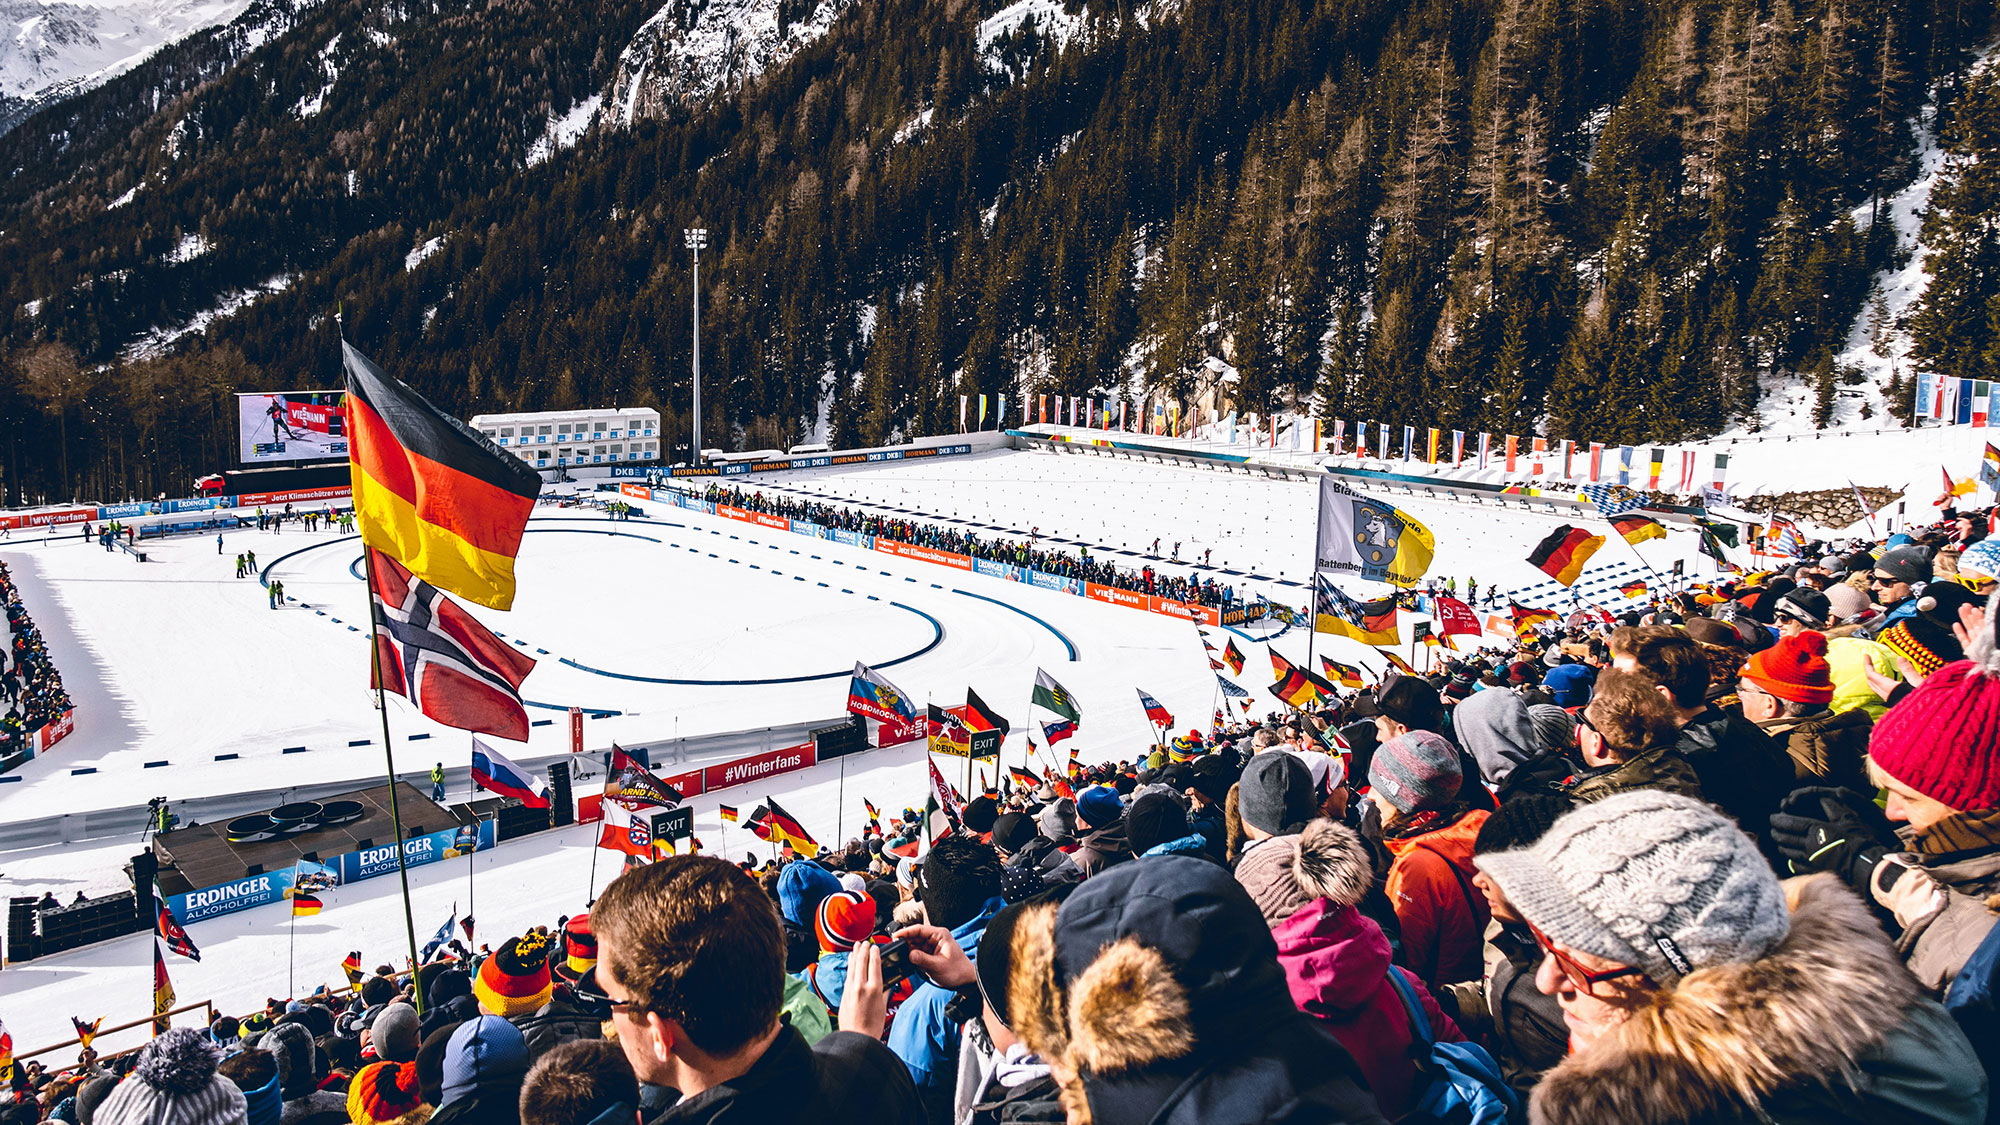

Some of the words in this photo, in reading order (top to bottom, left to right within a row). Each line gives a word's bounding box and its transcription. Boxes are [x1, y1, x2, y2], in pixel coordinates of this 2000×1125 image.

[793, 460, 806, 468] DKB
[811, 458, 825, 466] DKB
[615, 468, 635, 476] DKB
[726, 466, 741, 474] DKB
[271, 494, 288, 502] Jetzt
[178, 499, 210, 508] ERDINGER
[106, 505, 140, 515] ERDINGER
[1318, 558, 1367, 576] Rattenberg
[1368, 566, 1378, 575] im
[1094, 588, 1139, 605] VIESSMANN
[1415, 627, 1427, 637] EXIT
[973, 737, 996, 751] EXIT
[725, 754, 801, 783] #Winterfans
[635, 782, 650, 790] FAN
[620, 787, 647, 797] ARND
[658, 817, 686, 835] EXIT
[185, 876, 272, 910] ERDINGER
[186, 893, 270, 920] ALKOHOLFREI
